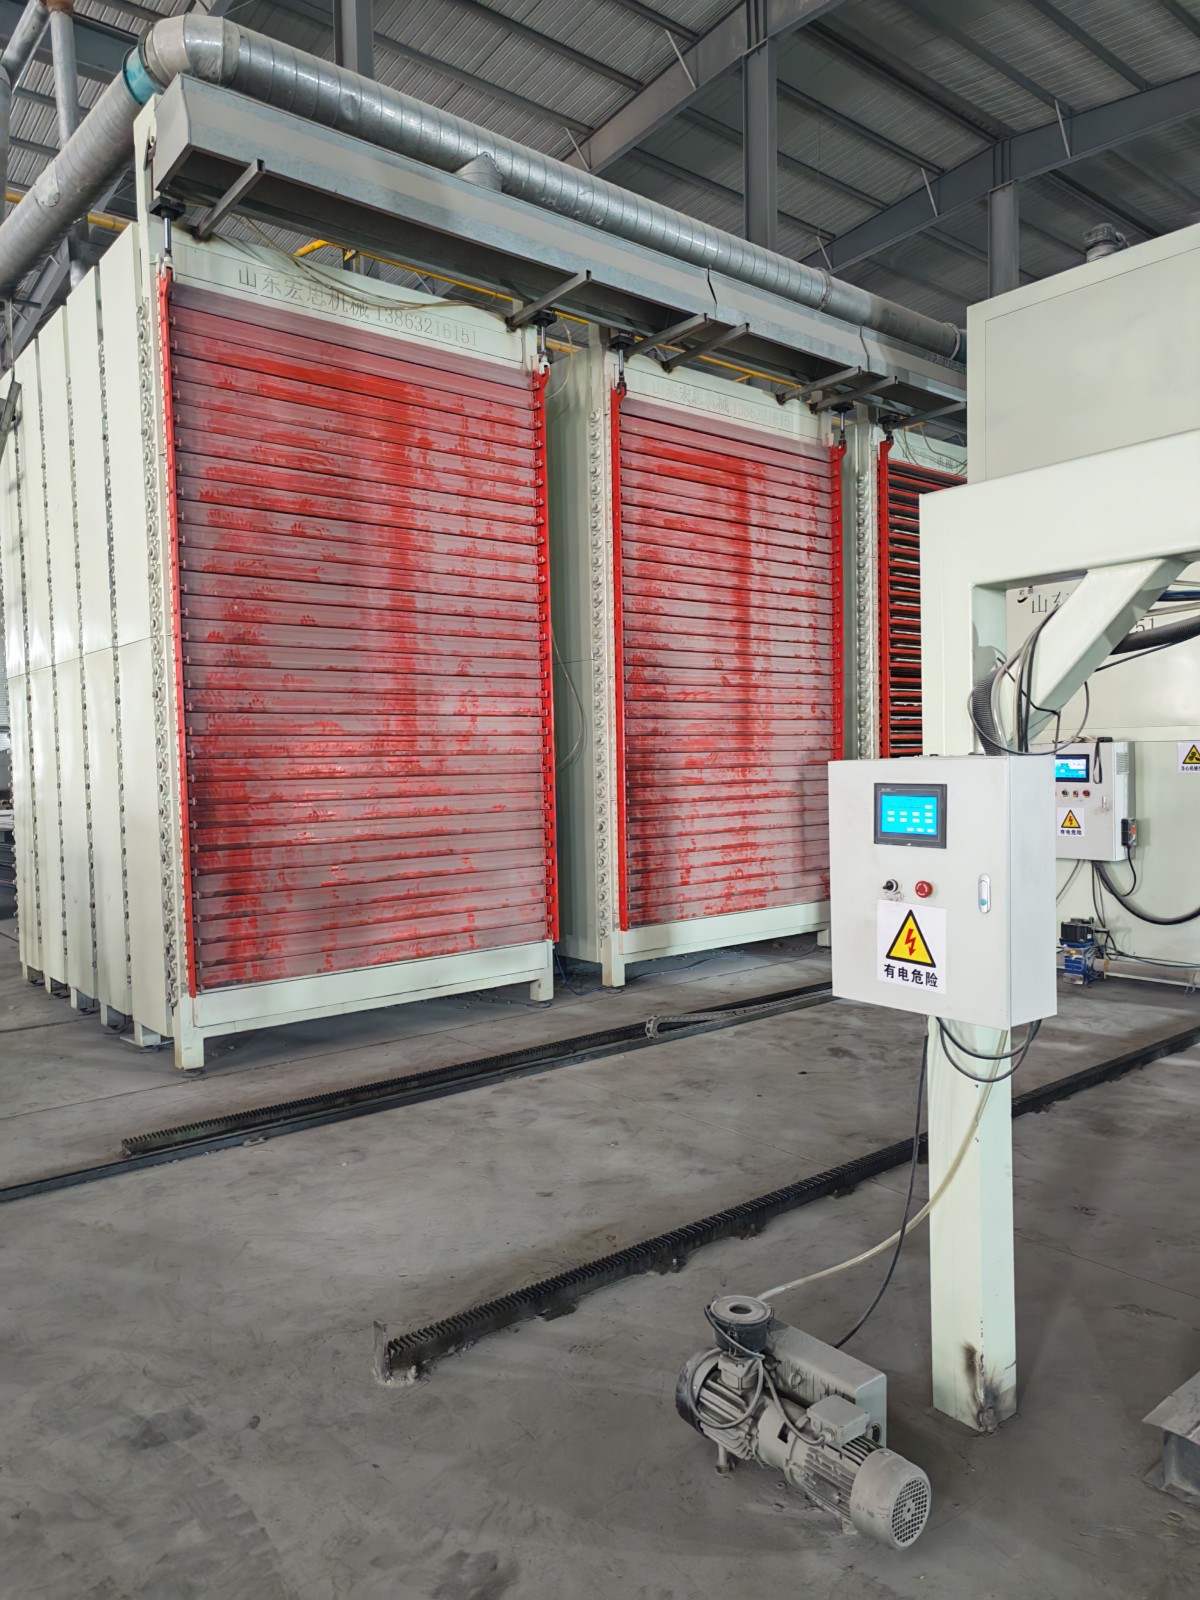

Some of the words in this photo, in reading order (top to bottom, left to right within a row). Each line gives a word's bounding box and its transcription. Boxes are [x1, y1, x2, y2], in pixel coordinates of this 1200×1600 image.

[376, 307, 478, 346] 13863216151
[883, 963, 939, 988] 有电危险
